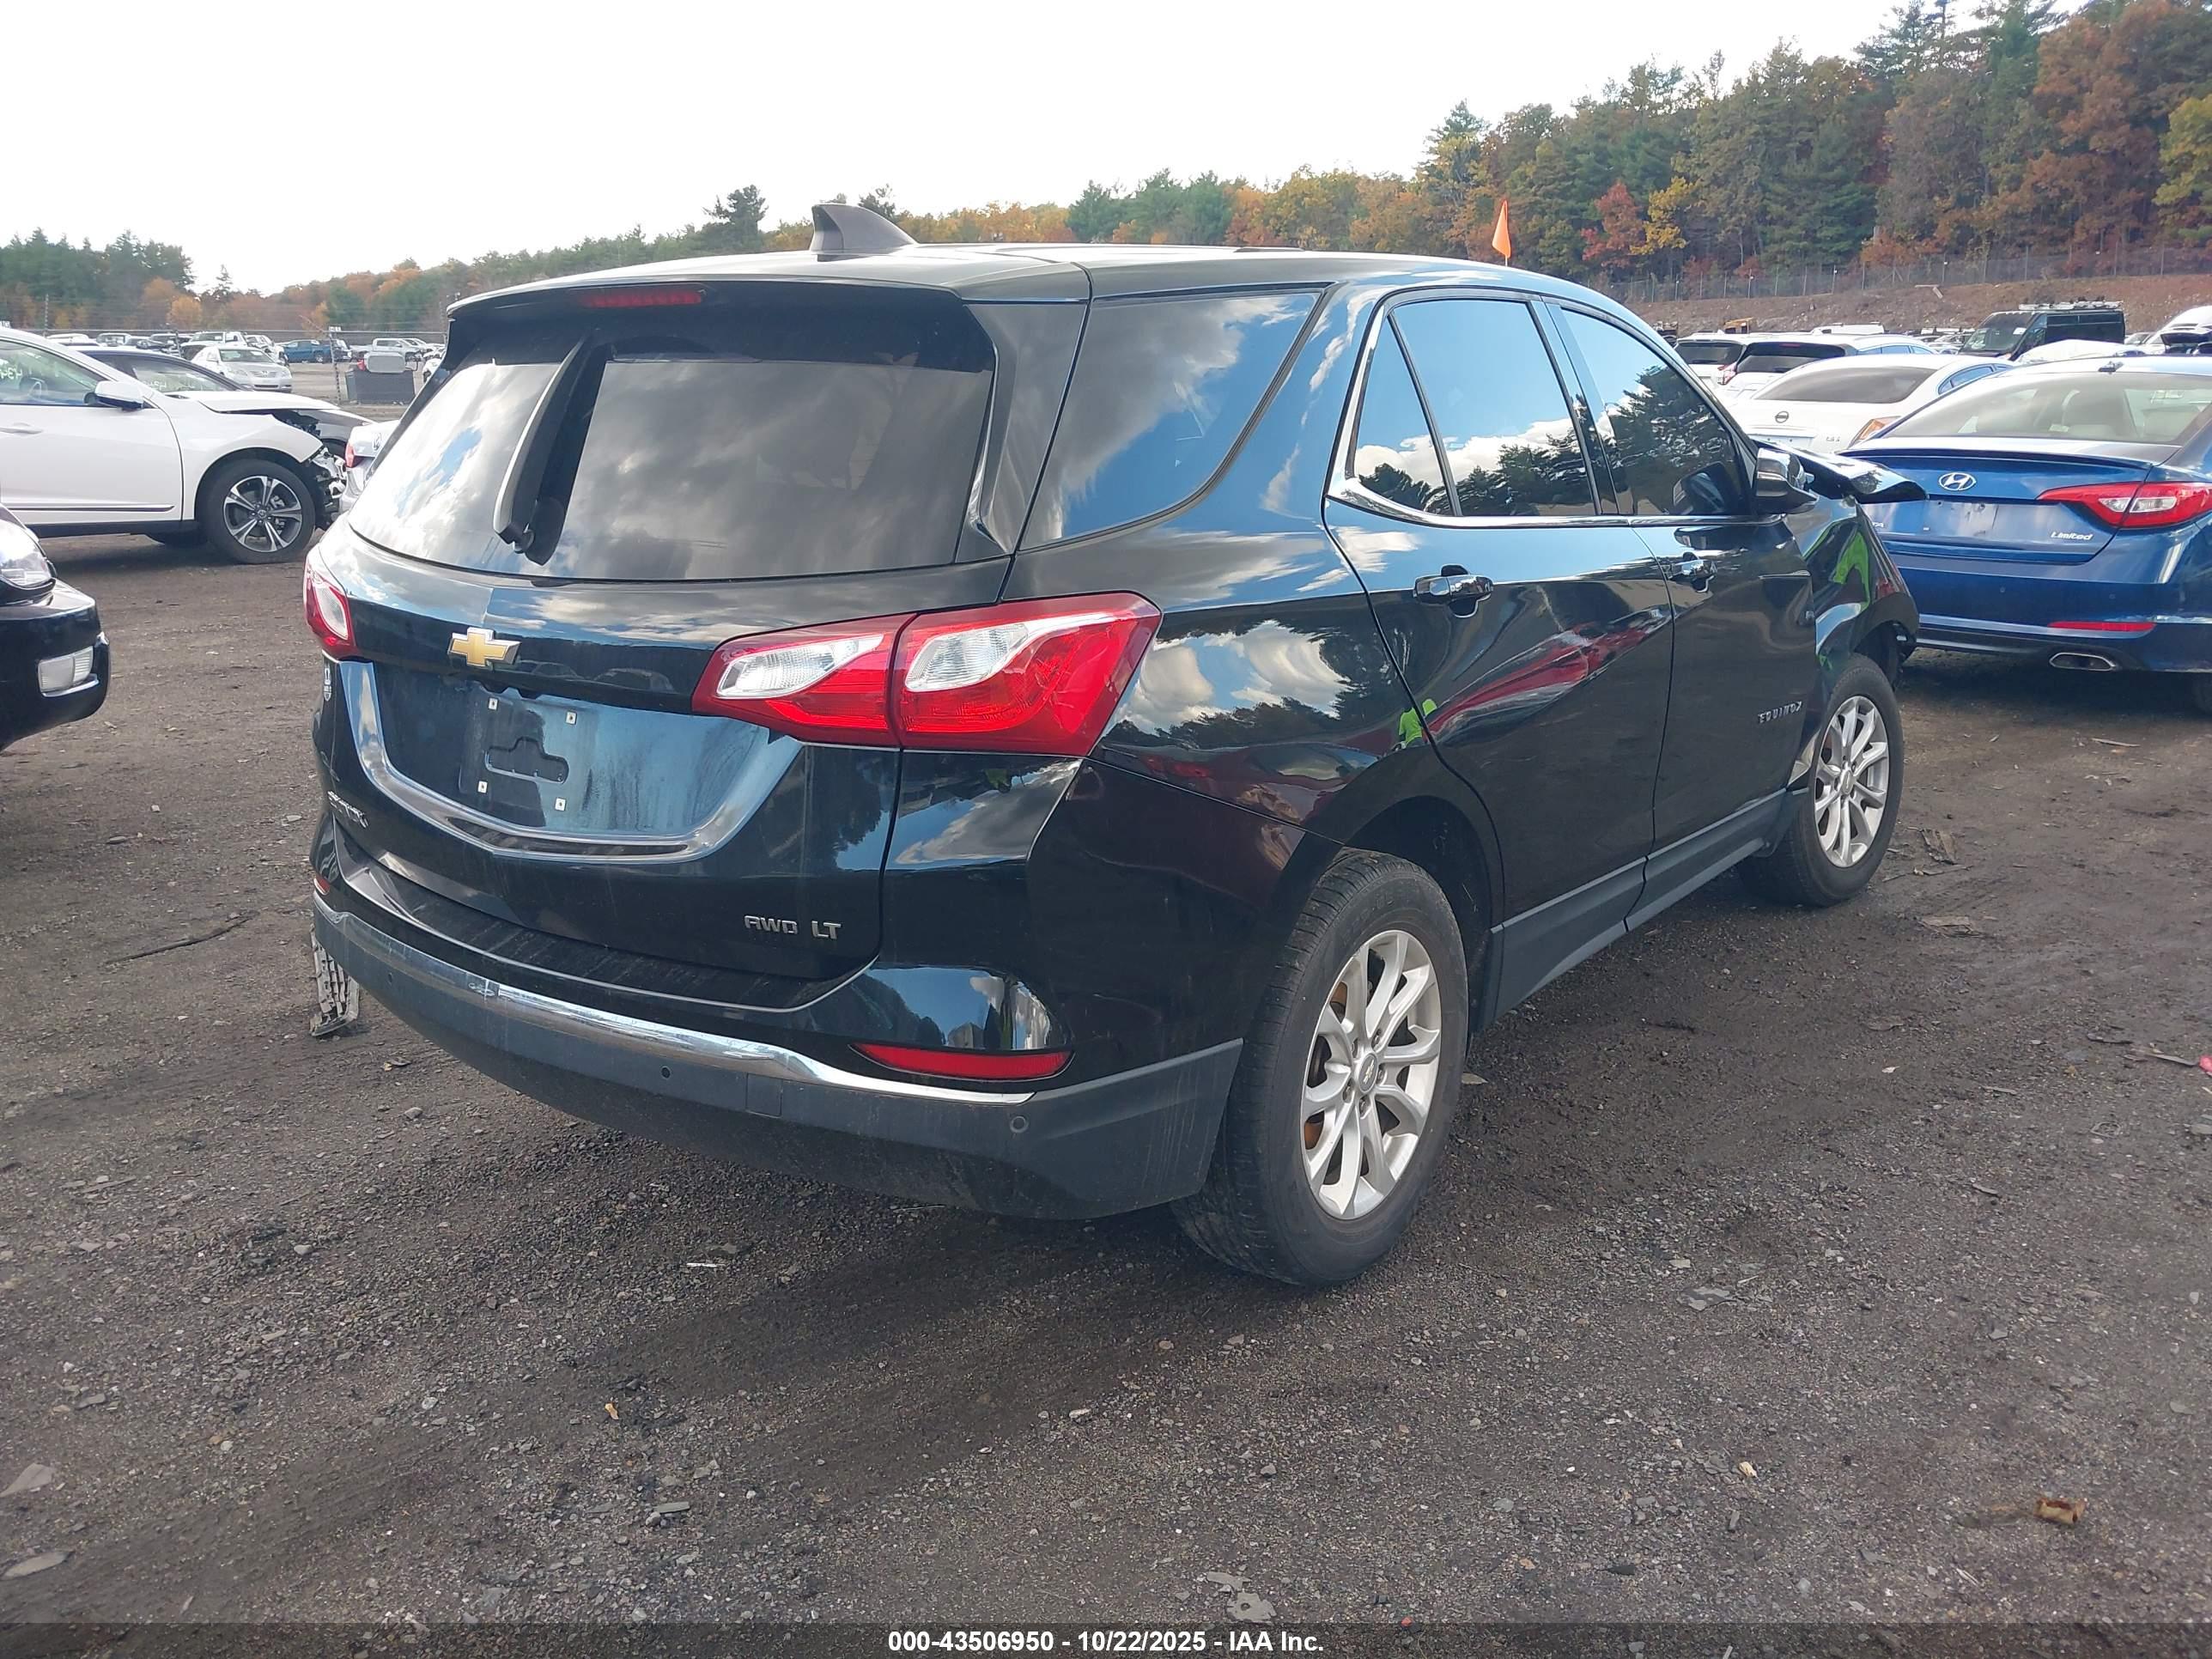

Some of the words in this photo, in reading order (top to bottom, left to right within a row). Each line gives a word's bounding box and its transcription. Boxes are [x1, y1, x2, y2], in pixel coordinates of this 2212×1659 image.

[2050, 531, 2094, 541] Limited
[744, 915, 799, 935] AWD
[811, 920, 842, 940] LT
